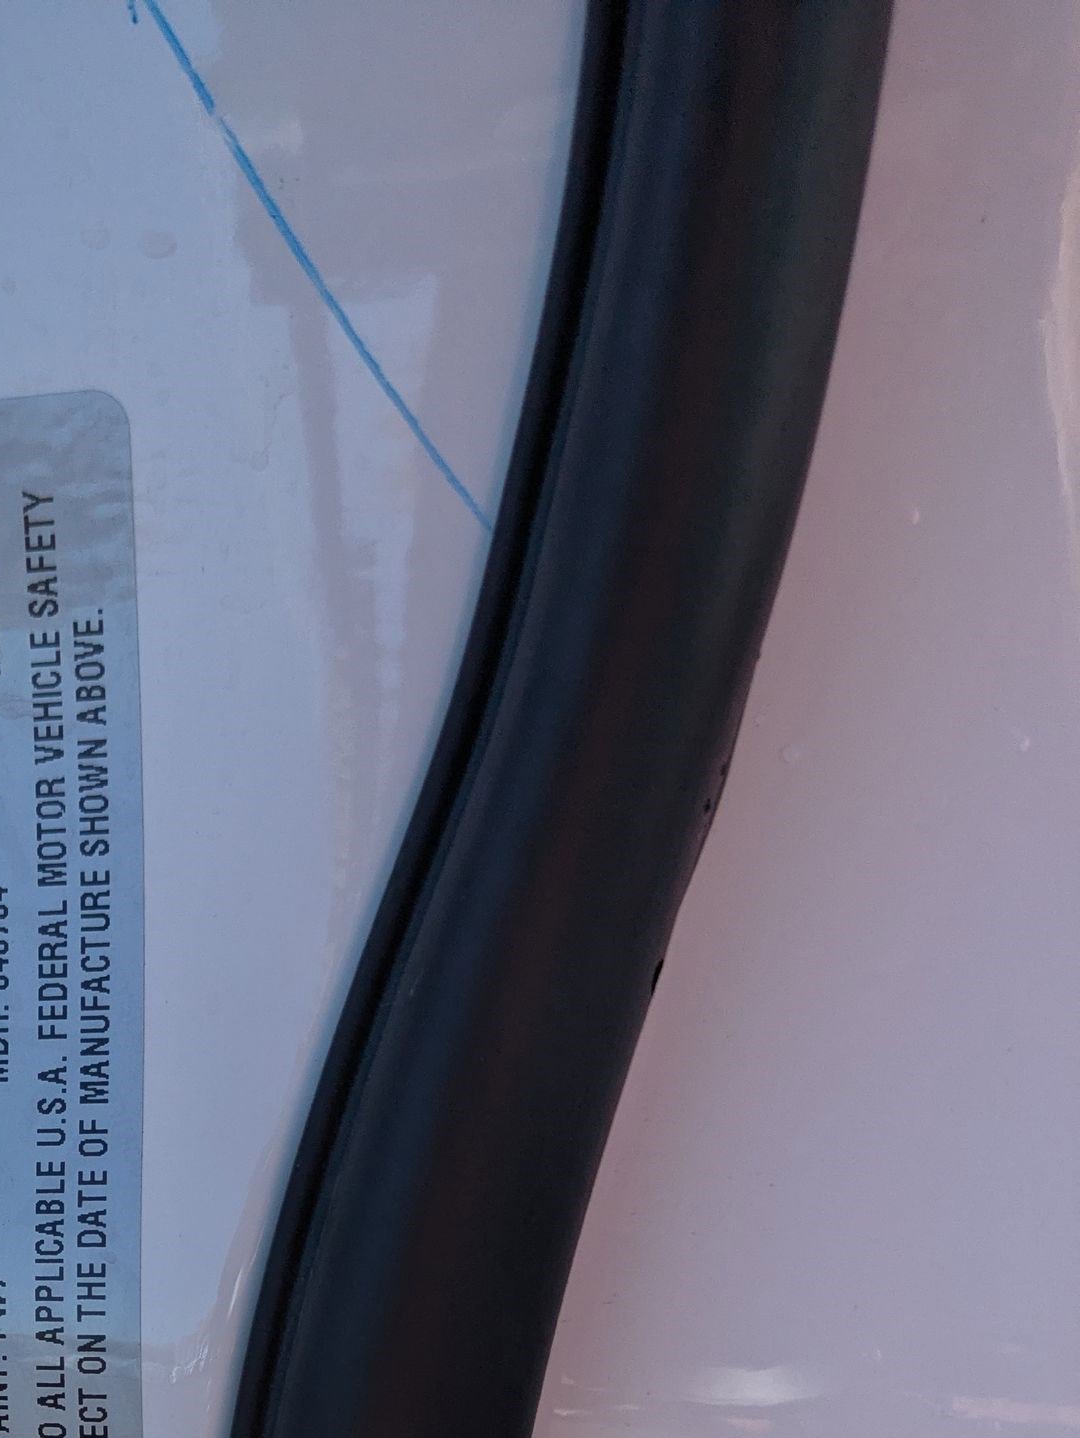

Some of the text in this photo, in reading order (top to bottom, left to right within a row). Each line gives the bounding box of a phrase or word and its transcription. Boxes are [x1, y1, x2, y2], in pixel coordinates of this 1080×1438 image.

[22, 492, 58, 617] SAFETY
[30, 632, 64, 765] VEHICLE
[73, 609, 106, 725] ABOVE.
[36, 777, 67, 886] MOTOR
[78, 739, 109, 856] SHOWN
[38, 900, 67, 1039] FEDERAL
[80, 871, 110, 1104] MANUFACTURE
[37, 1057, 67, 1146] U.S.A.
[79, 1120, 108, 1156] OF
[35, 1162, 65, 1345] APPLICABLE
[77, 1171, 107, 1247] DATE
[77, 1263, 106, 1322] THE
[36, 1357, 65, 1410] ALL
[77, 1335, 106, 1374] ON
